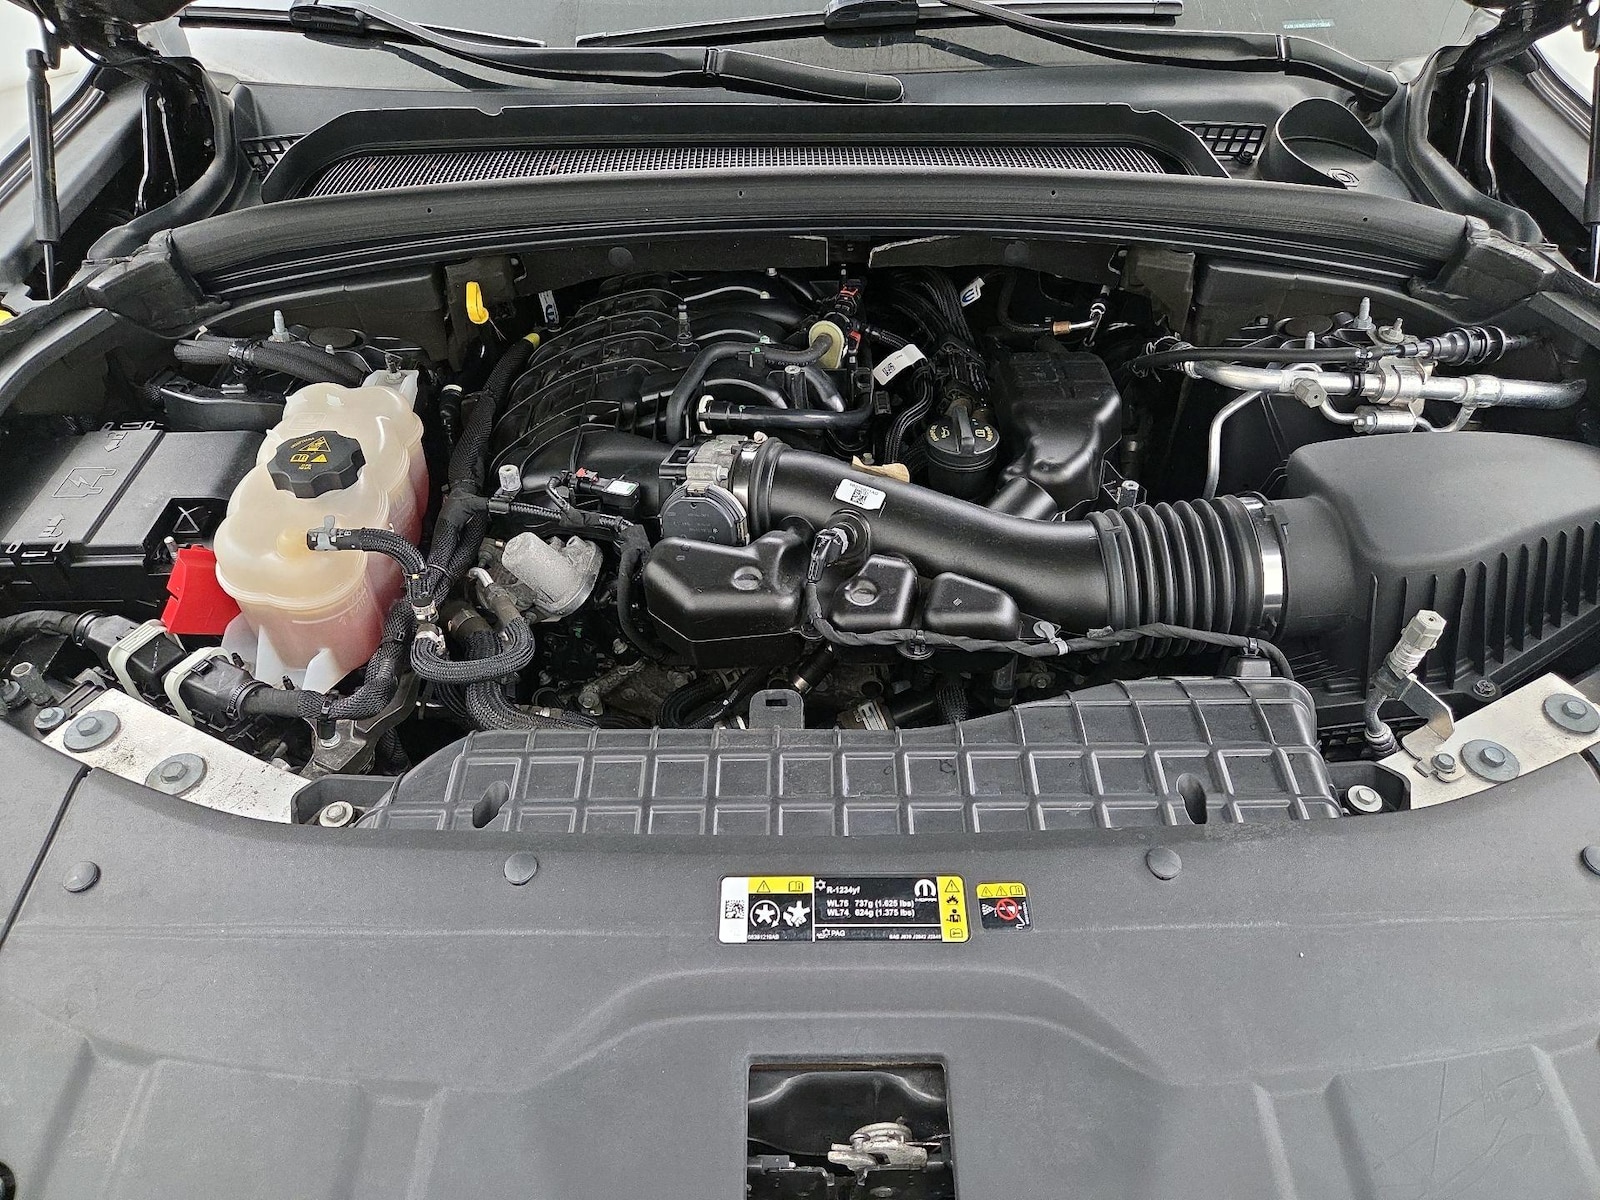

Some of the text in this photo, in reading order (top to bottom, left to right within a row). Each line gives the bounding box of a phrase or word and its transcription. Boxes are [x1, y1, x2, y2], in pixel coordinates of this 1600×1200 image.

[826, 885, 861, 896] R-1234yf
[826, 899, 915, 909] WL75 737g (1.625 lbs)
[827, 908, 916, 918] WL74 624g (1.375 lbs)
[831, 929, 846, 937] PAG
